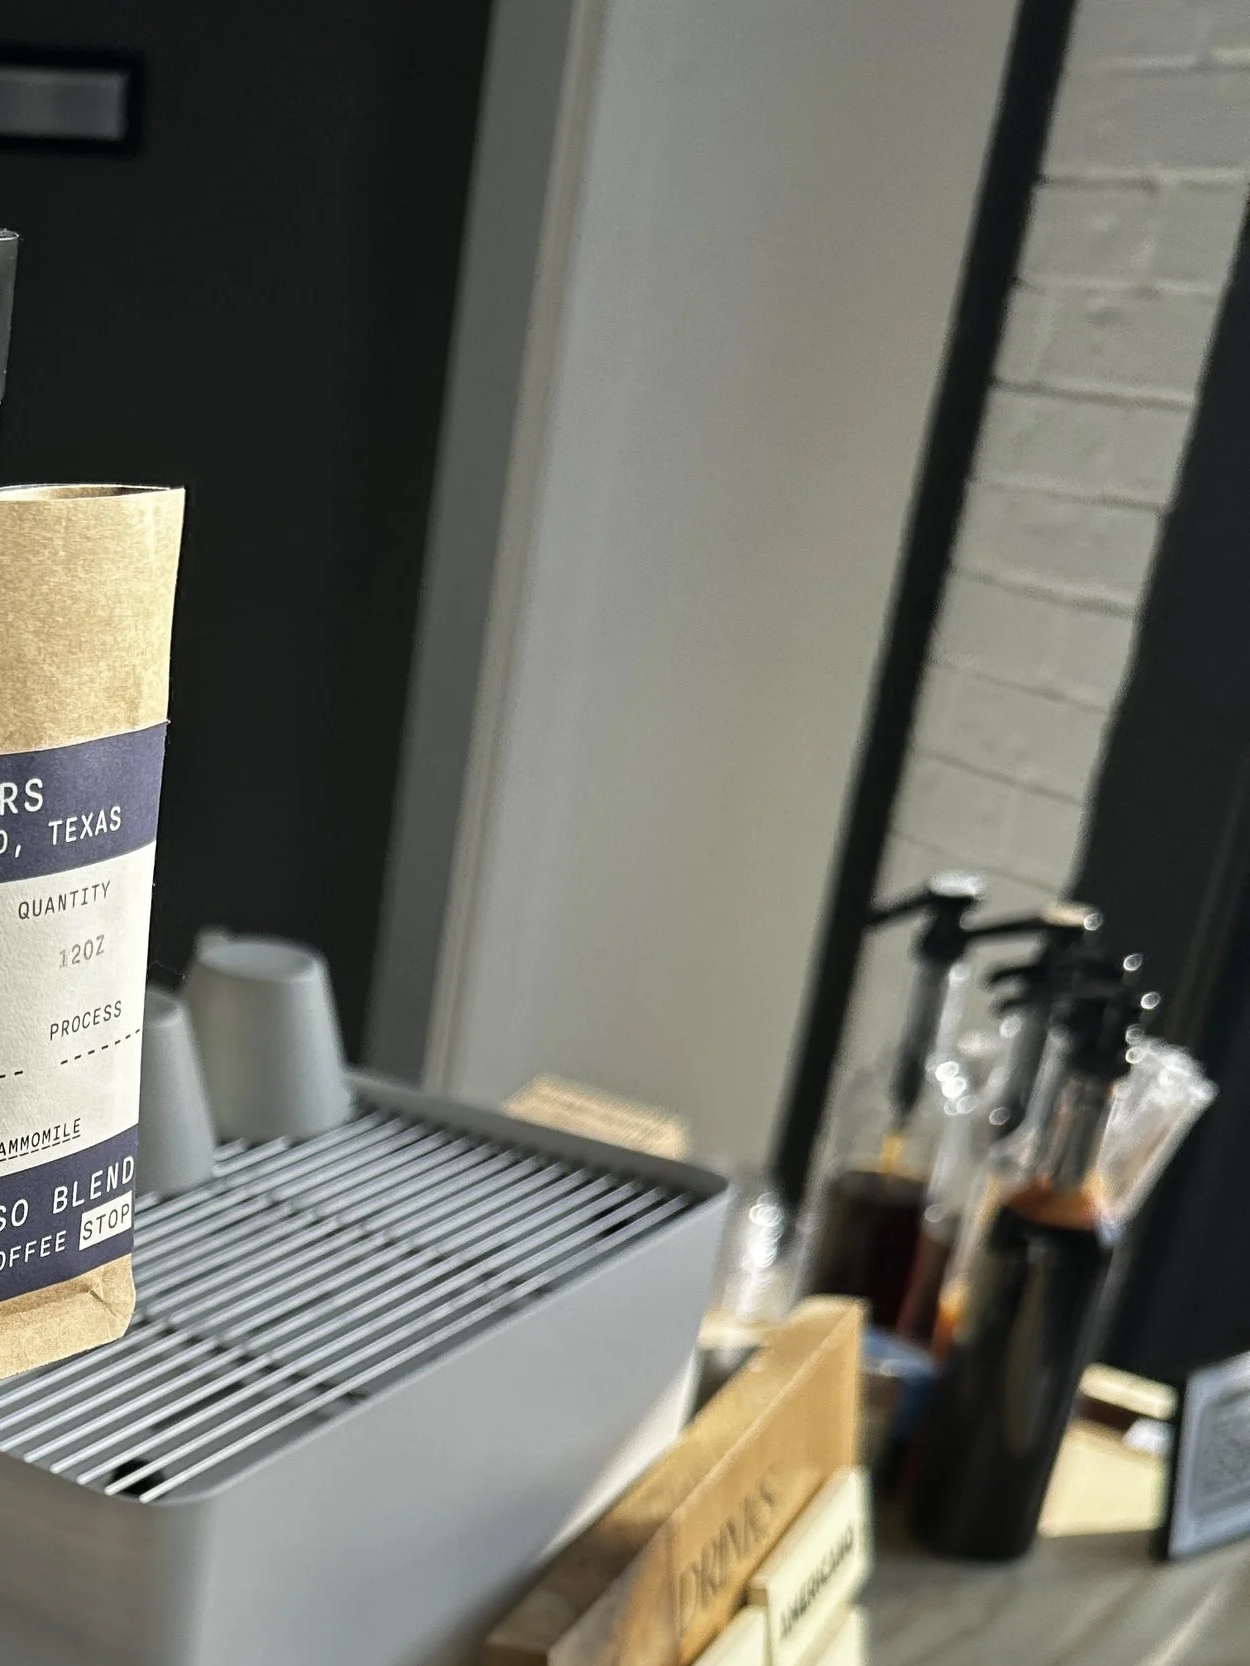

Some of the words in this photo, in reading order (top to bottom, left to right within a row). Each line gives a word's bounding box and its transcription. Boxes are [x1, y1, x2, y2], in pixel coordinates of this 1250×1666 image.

[48, 805, 122, 847] TEXAS
[18, 880, 111, 920] QUANTITY
[50, 1000, 122, 1041] PROCESS
[52, 1155, 135, 1215] BLEND
[81, 1202, 131, 1242] STOP
